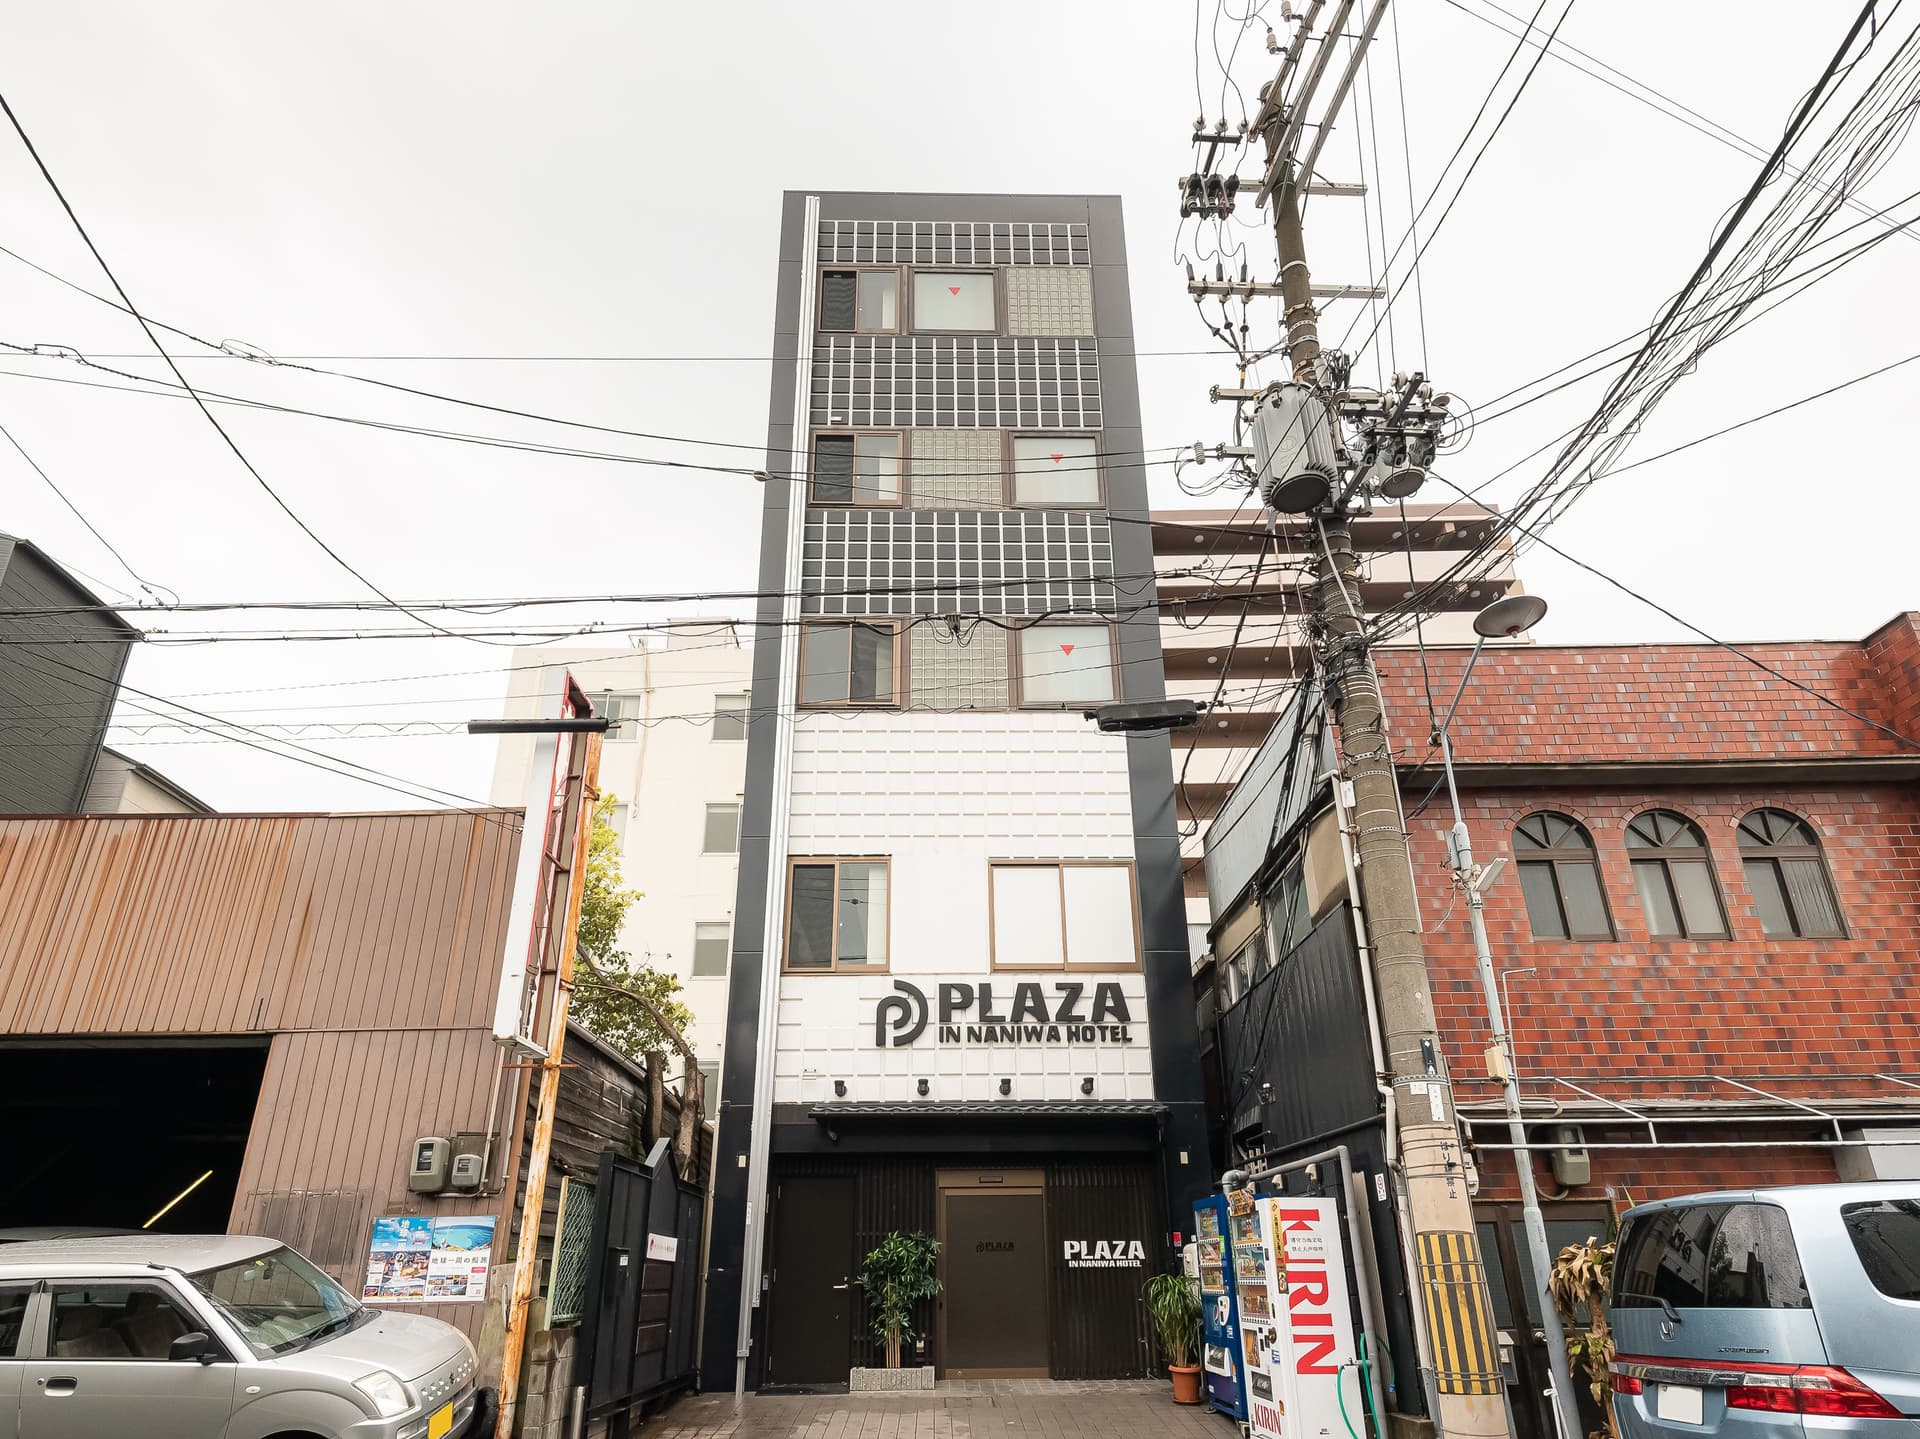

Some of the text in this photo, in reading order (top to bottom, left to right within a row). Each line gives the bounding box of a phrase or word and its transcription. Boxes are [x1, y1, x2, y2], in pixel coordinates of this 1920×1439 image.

[938, 982, 1131, 1023] PLAZA
[938, 1025, 1133, 1043] IN NANIWA HOTEL
[986, 1241, 1015, 1249] PLAZA
[1063, 1240, 1146, 1260] PLAZA
[1068, 1260, 1142, 1268] IN NANIWA HOTEL
[1280, 1209, 1338, 1374] KIRIN
[1254, 1402, 1282, 1436] KIRIN
